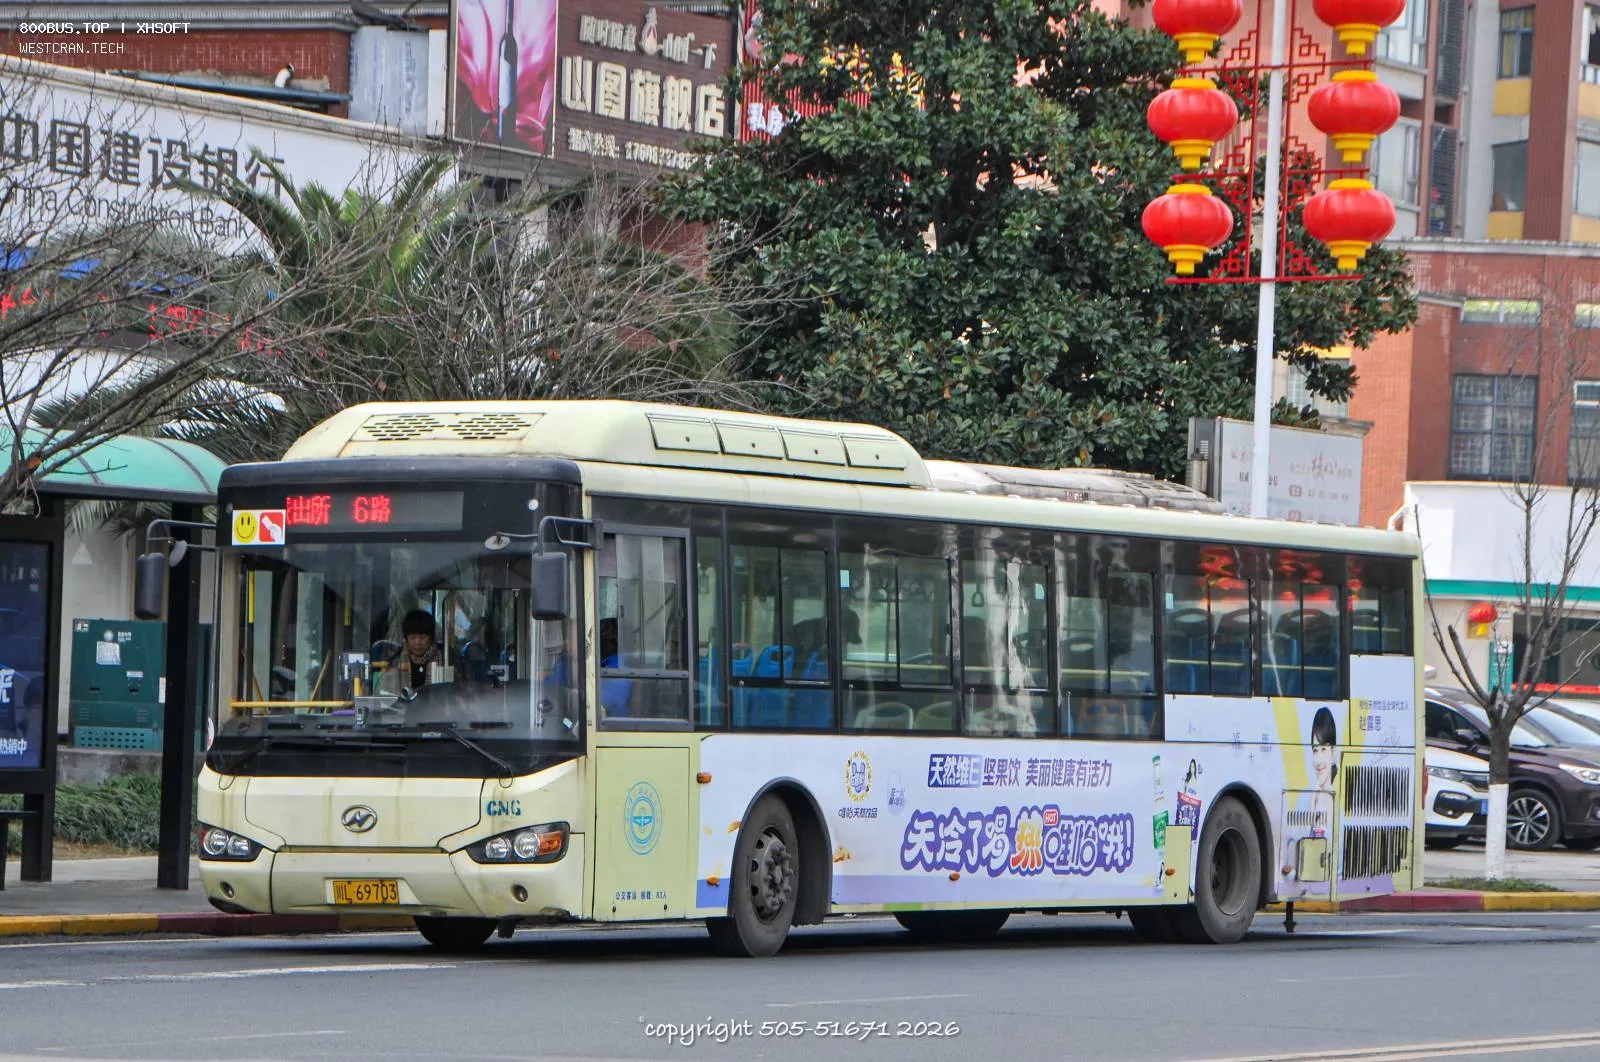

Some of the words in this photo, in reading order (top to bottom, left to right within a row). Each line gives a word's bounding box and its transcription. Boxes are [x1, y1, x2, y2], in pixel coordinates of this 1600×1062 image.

[561, 55, 725, 137] 山图旗舰店
[0, 113, 286, 199] 中国建设银行
[200, 206, 249, 240] Bank
[354, 495, 391, 524] 6路
[1025, 757, 1112, 788] 美丽健康有活力
[1044, 812, 1058, 824] HOT
